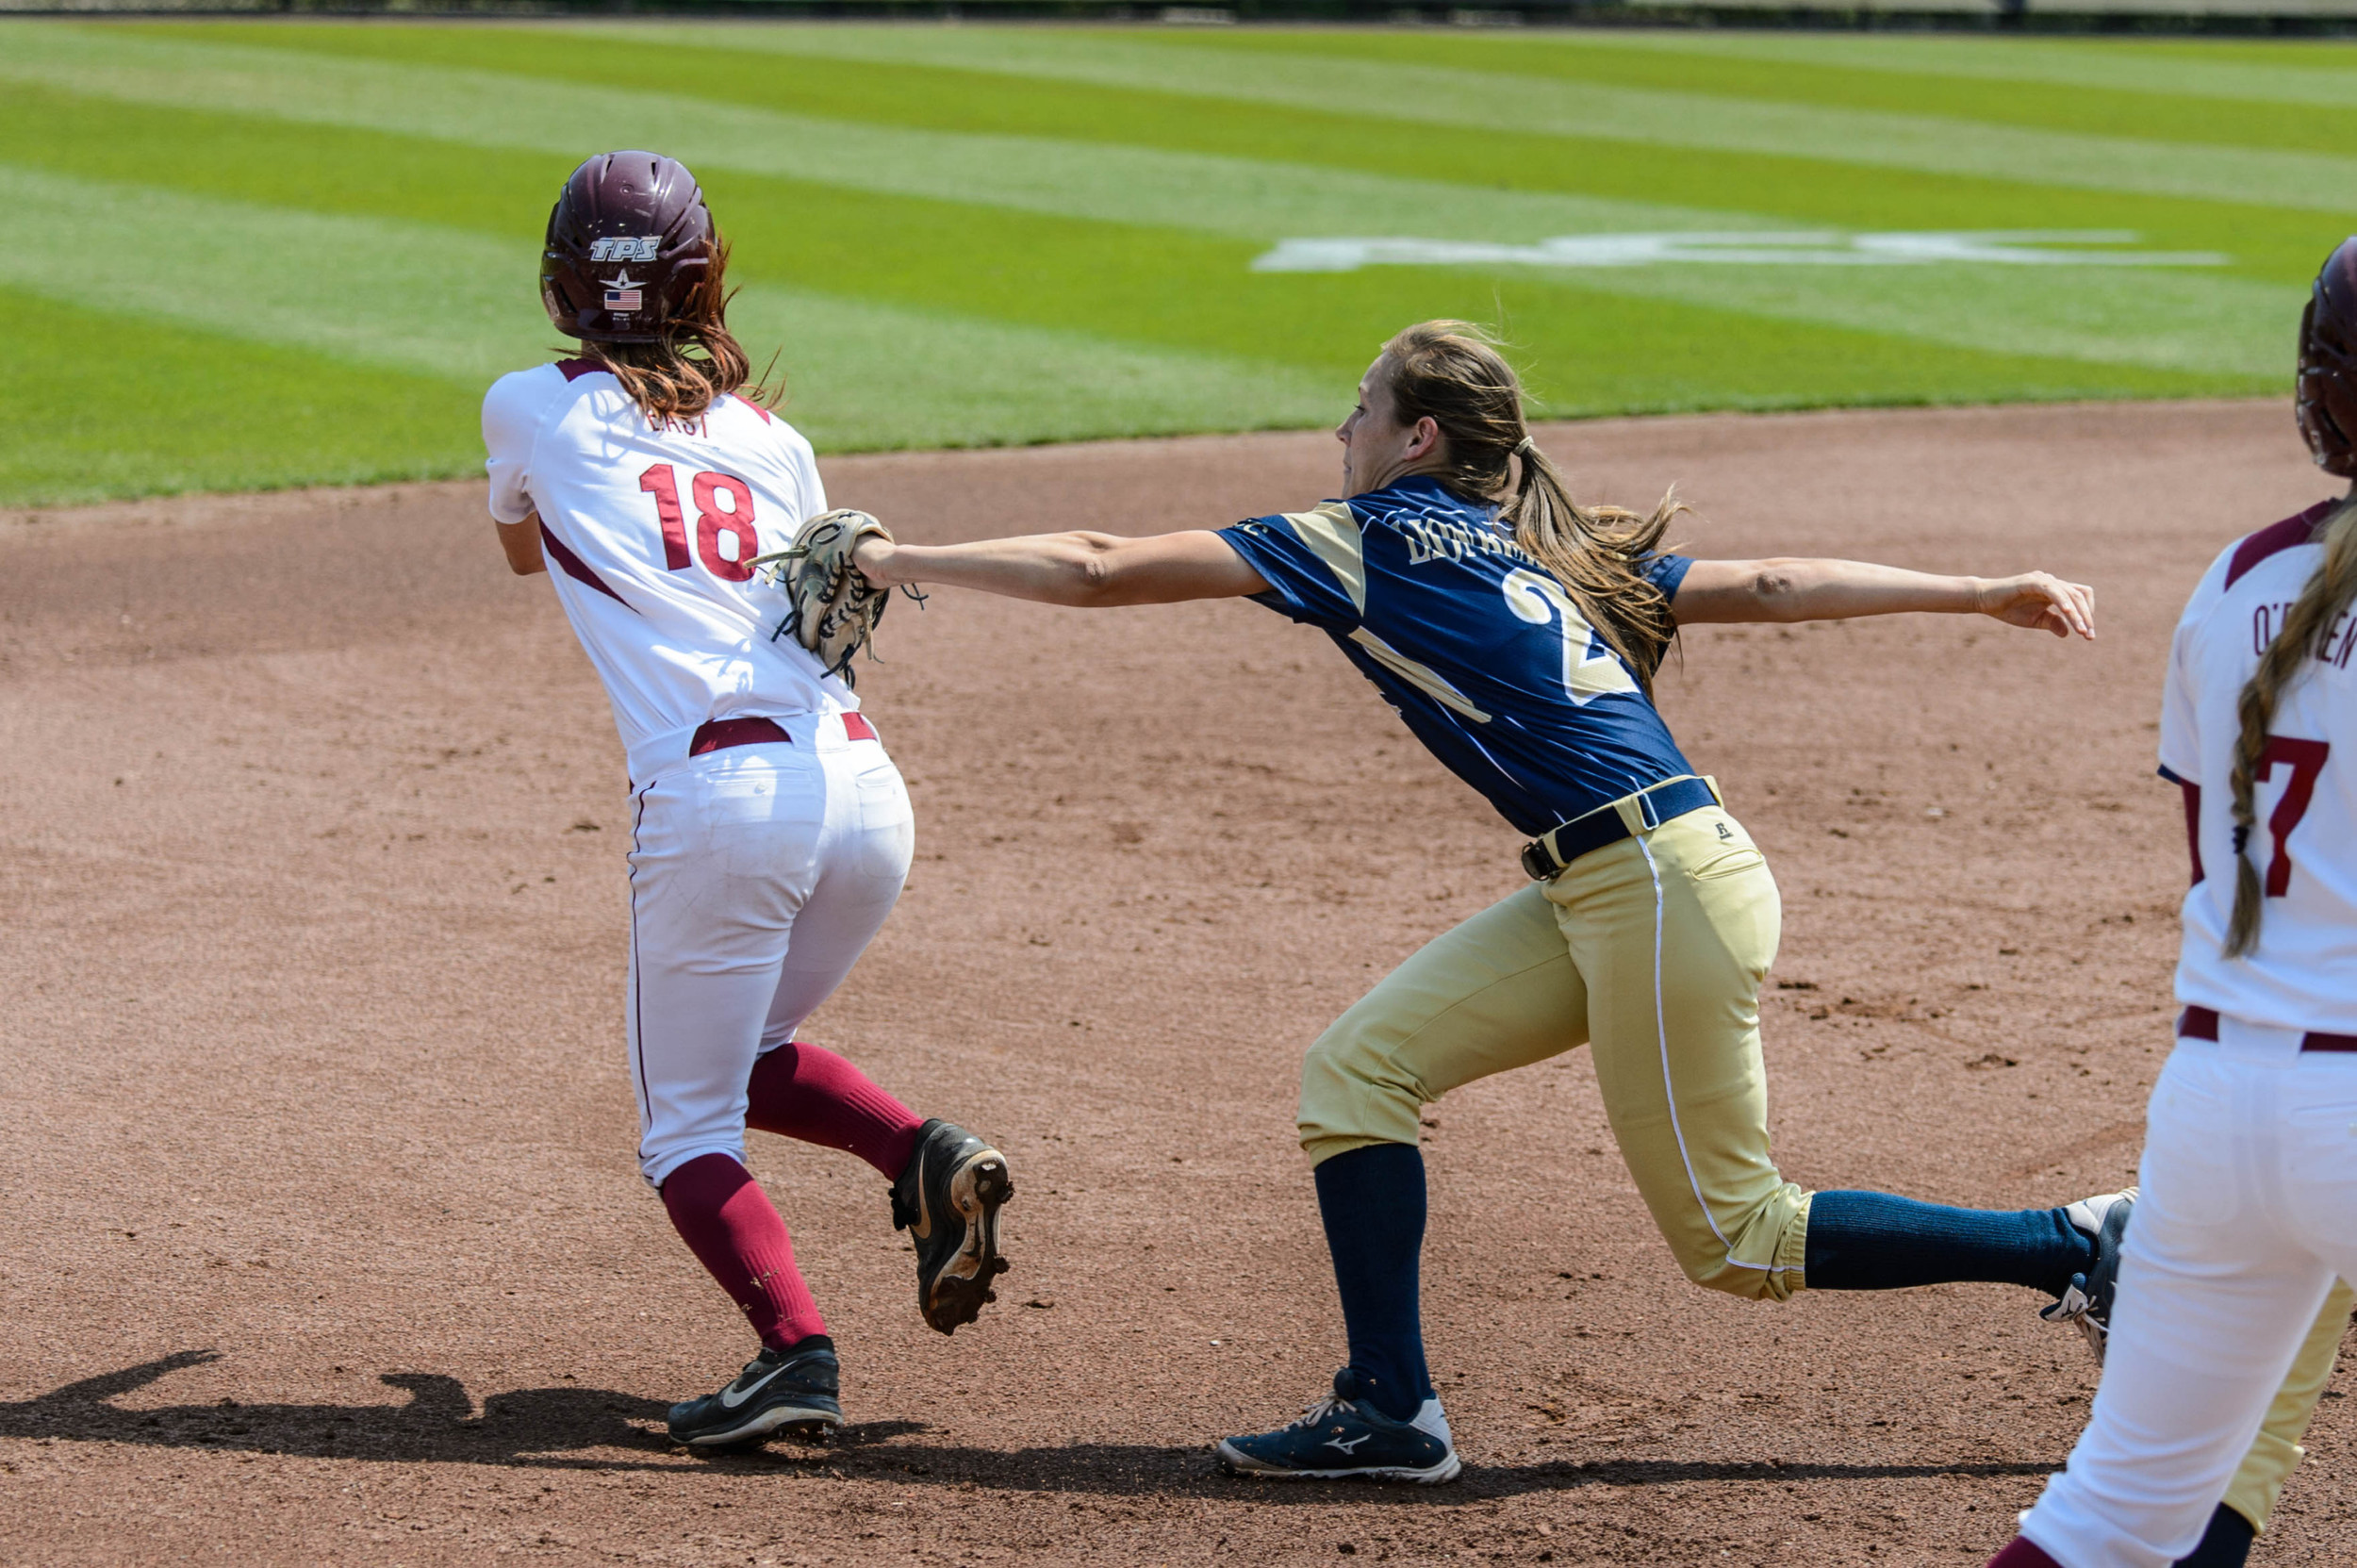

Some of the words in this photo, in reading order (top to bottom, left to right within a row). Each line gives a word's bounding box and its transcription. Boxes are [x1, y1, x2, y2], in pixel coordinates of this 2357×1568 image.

[589, 236, 663, 262] TPS
[638, 463, 759, 583] 18
[2253, 734, 2331, 898] 7
